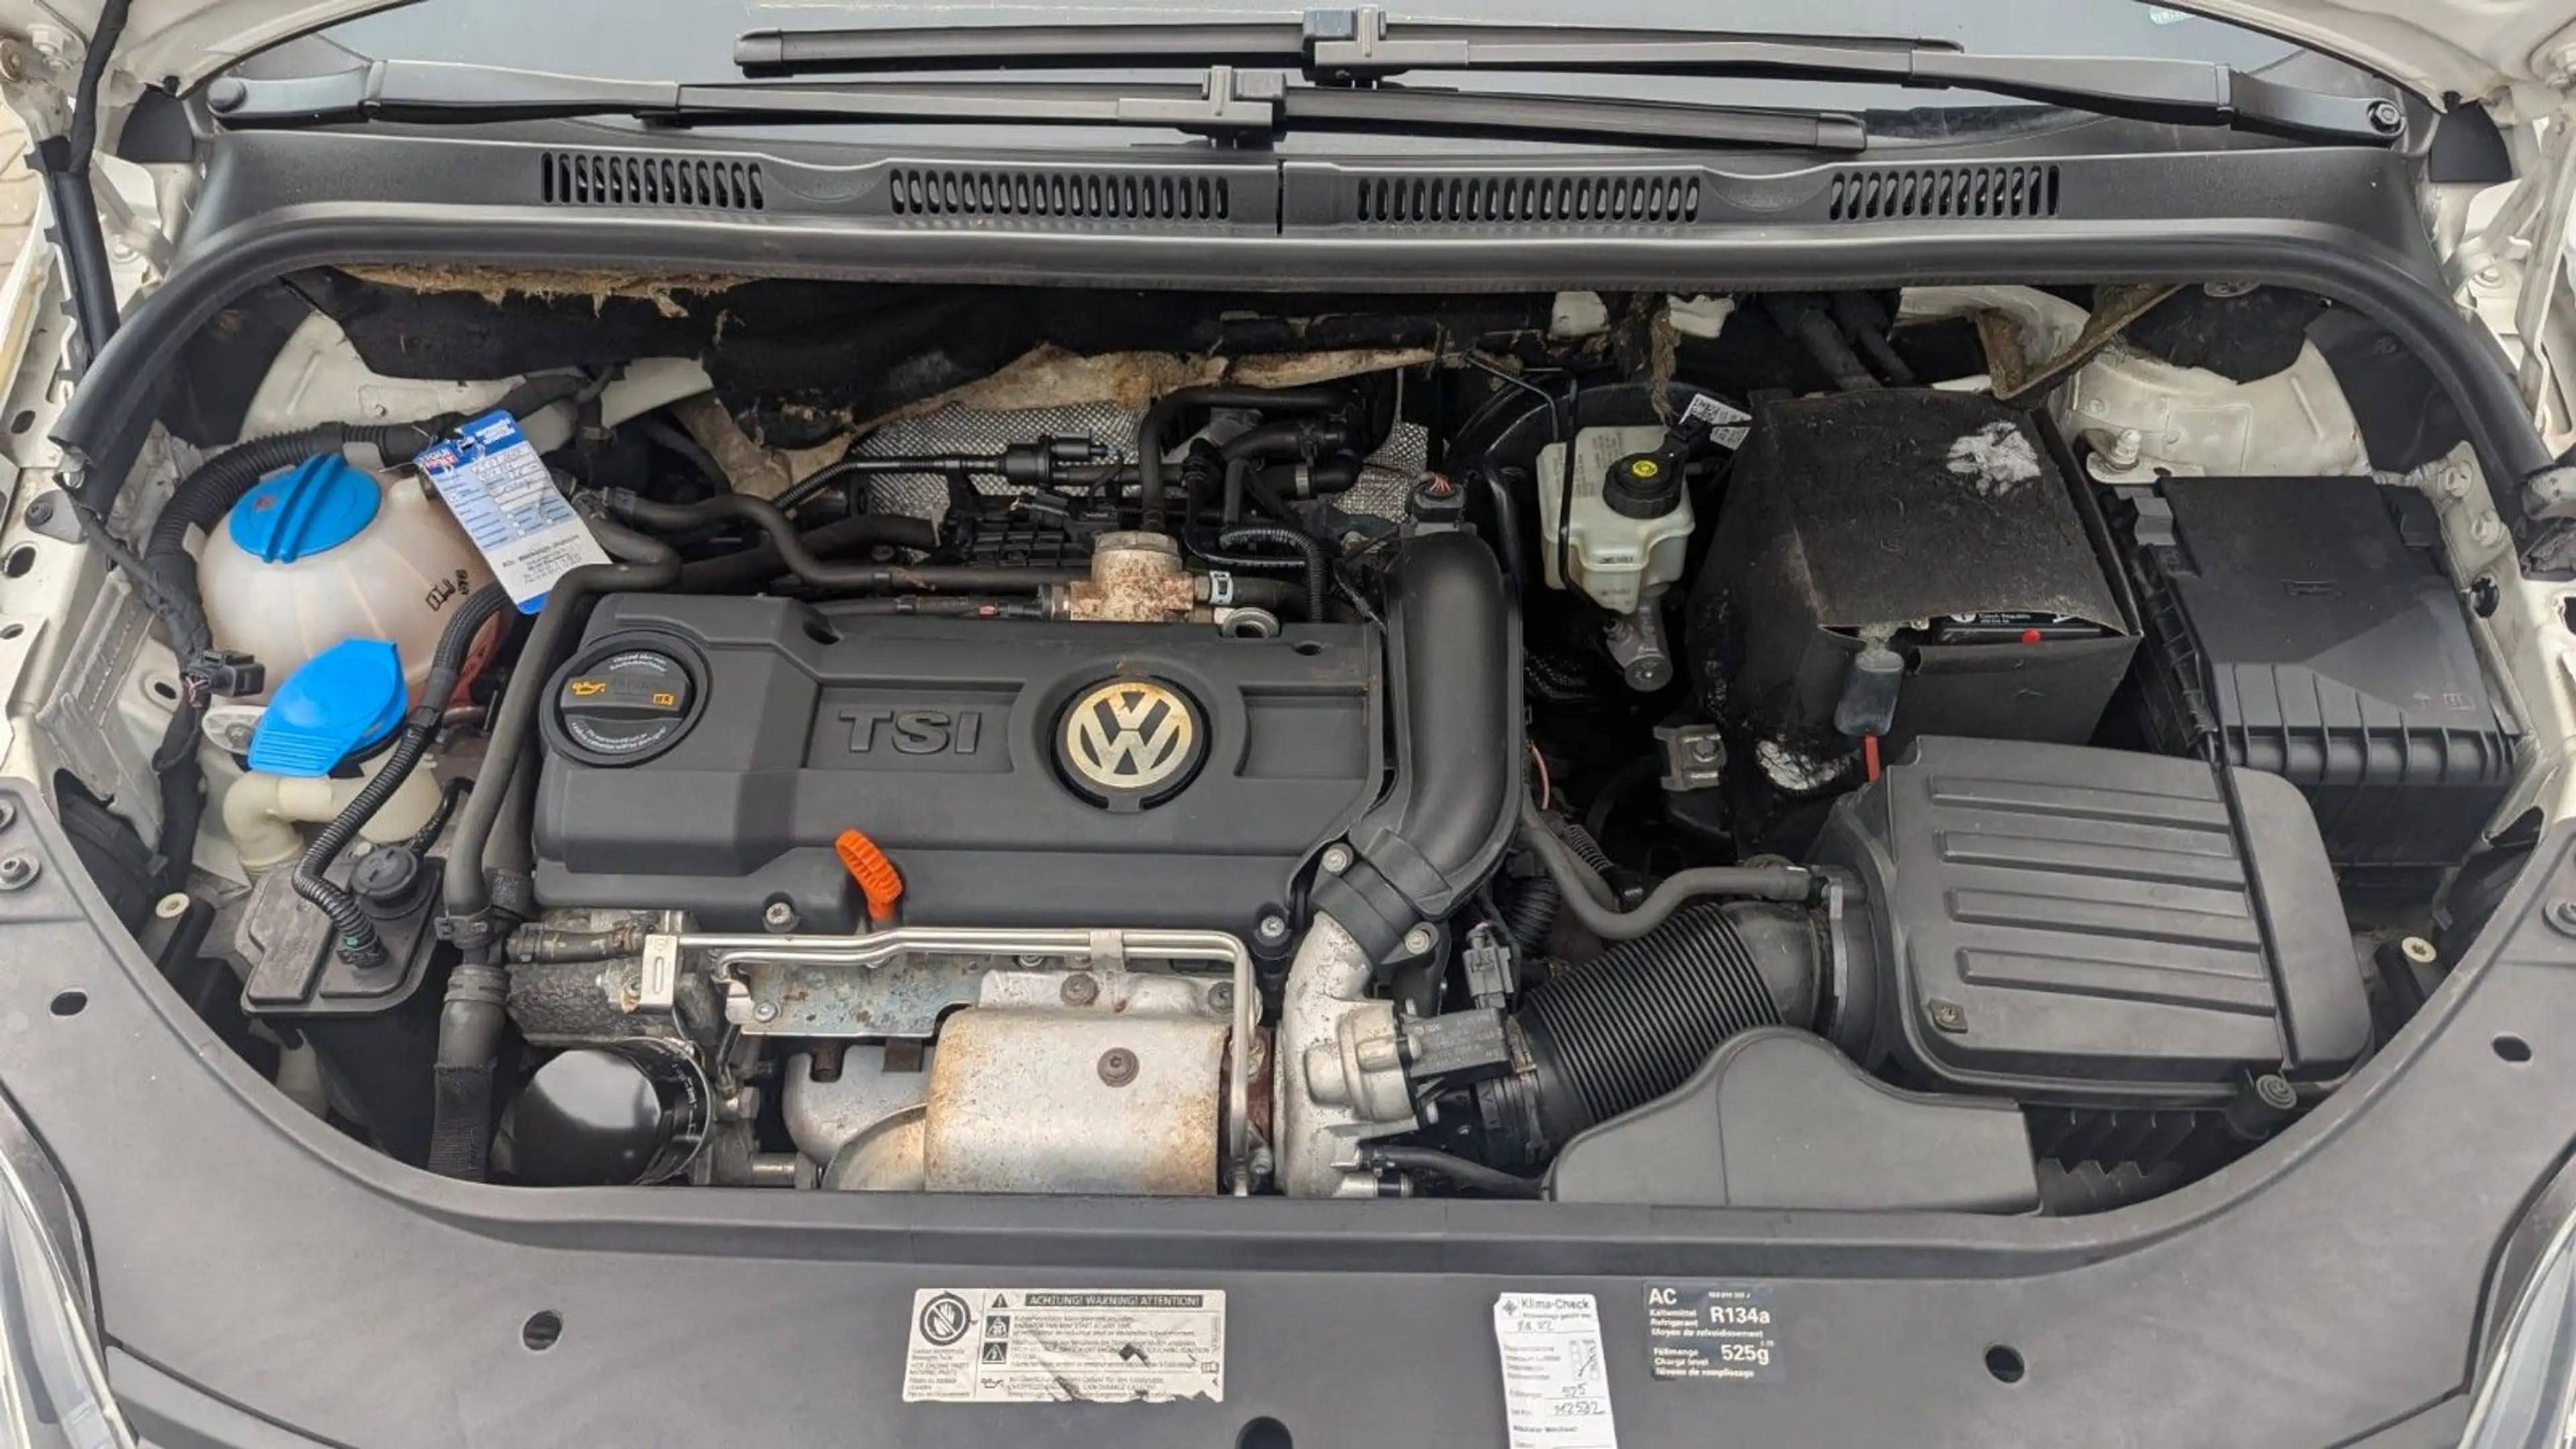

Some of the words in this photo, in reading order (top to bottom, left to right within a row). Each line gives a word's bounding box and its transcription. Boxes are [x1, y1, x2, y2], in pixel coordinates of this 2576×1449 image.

[838, 709, 981, 754] TSI
[1030, 1295, 1083, 1306] ACHTUNG!
[1085, 1295, 1139, 1306] WARNING!
[1140, 1295, 1199, 1306] ATTENTION!
[1521, 1296, 1589, 1310] Klima-Check
[1648, 1287, 1678, 1305] AC
[1710, 1305, 1771, 1324] R134a
[1683, 1328, 1695, 1337] de
[1720, 1344, 1770, 1365] 525g
[1654, 1357, 1686, 1367] Charge
[1688, 1367, 1700, 1377] de
